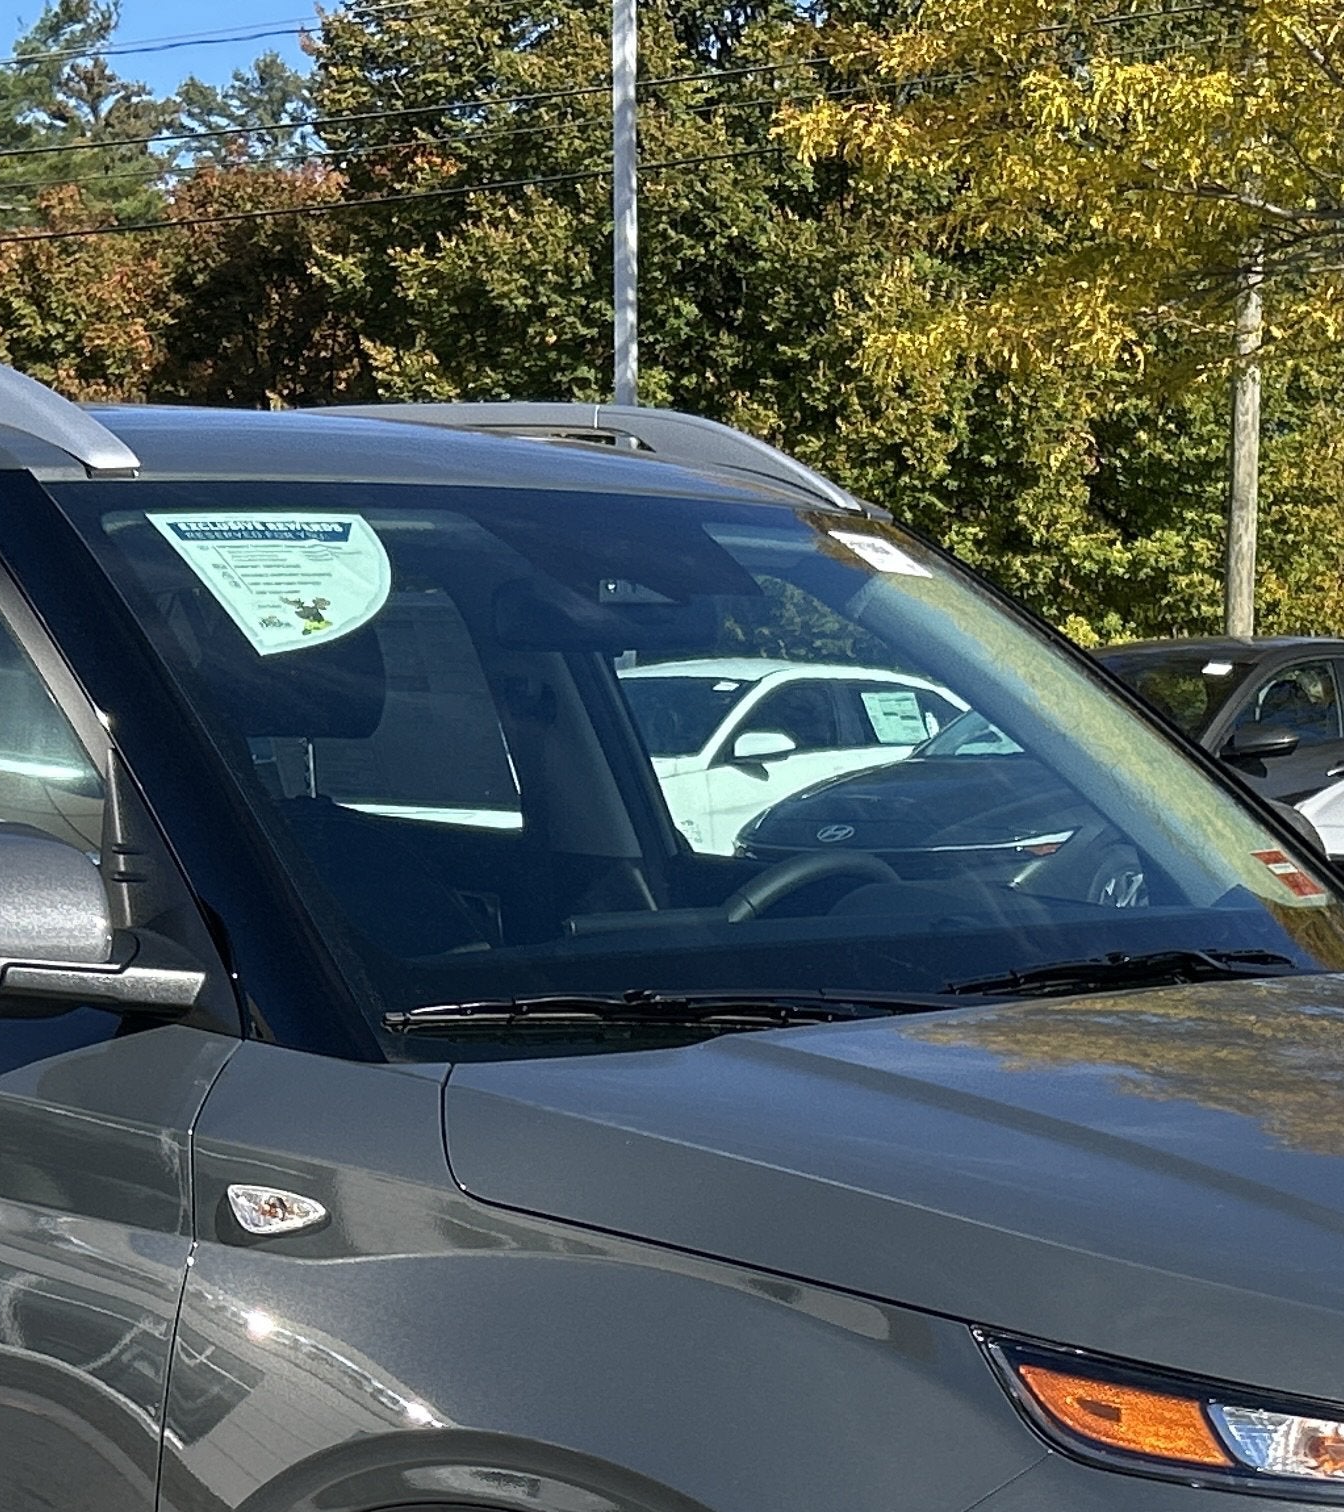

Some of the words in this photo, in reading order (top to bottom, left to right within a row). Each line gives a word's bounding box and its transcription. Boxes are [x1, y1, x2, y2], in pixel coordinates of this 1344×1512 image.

[177, 520, 265, 532] EXCLUSIVE
[266, 521, 344, 533] REWARDS
[184, 531, 263, 540] RESERVED
